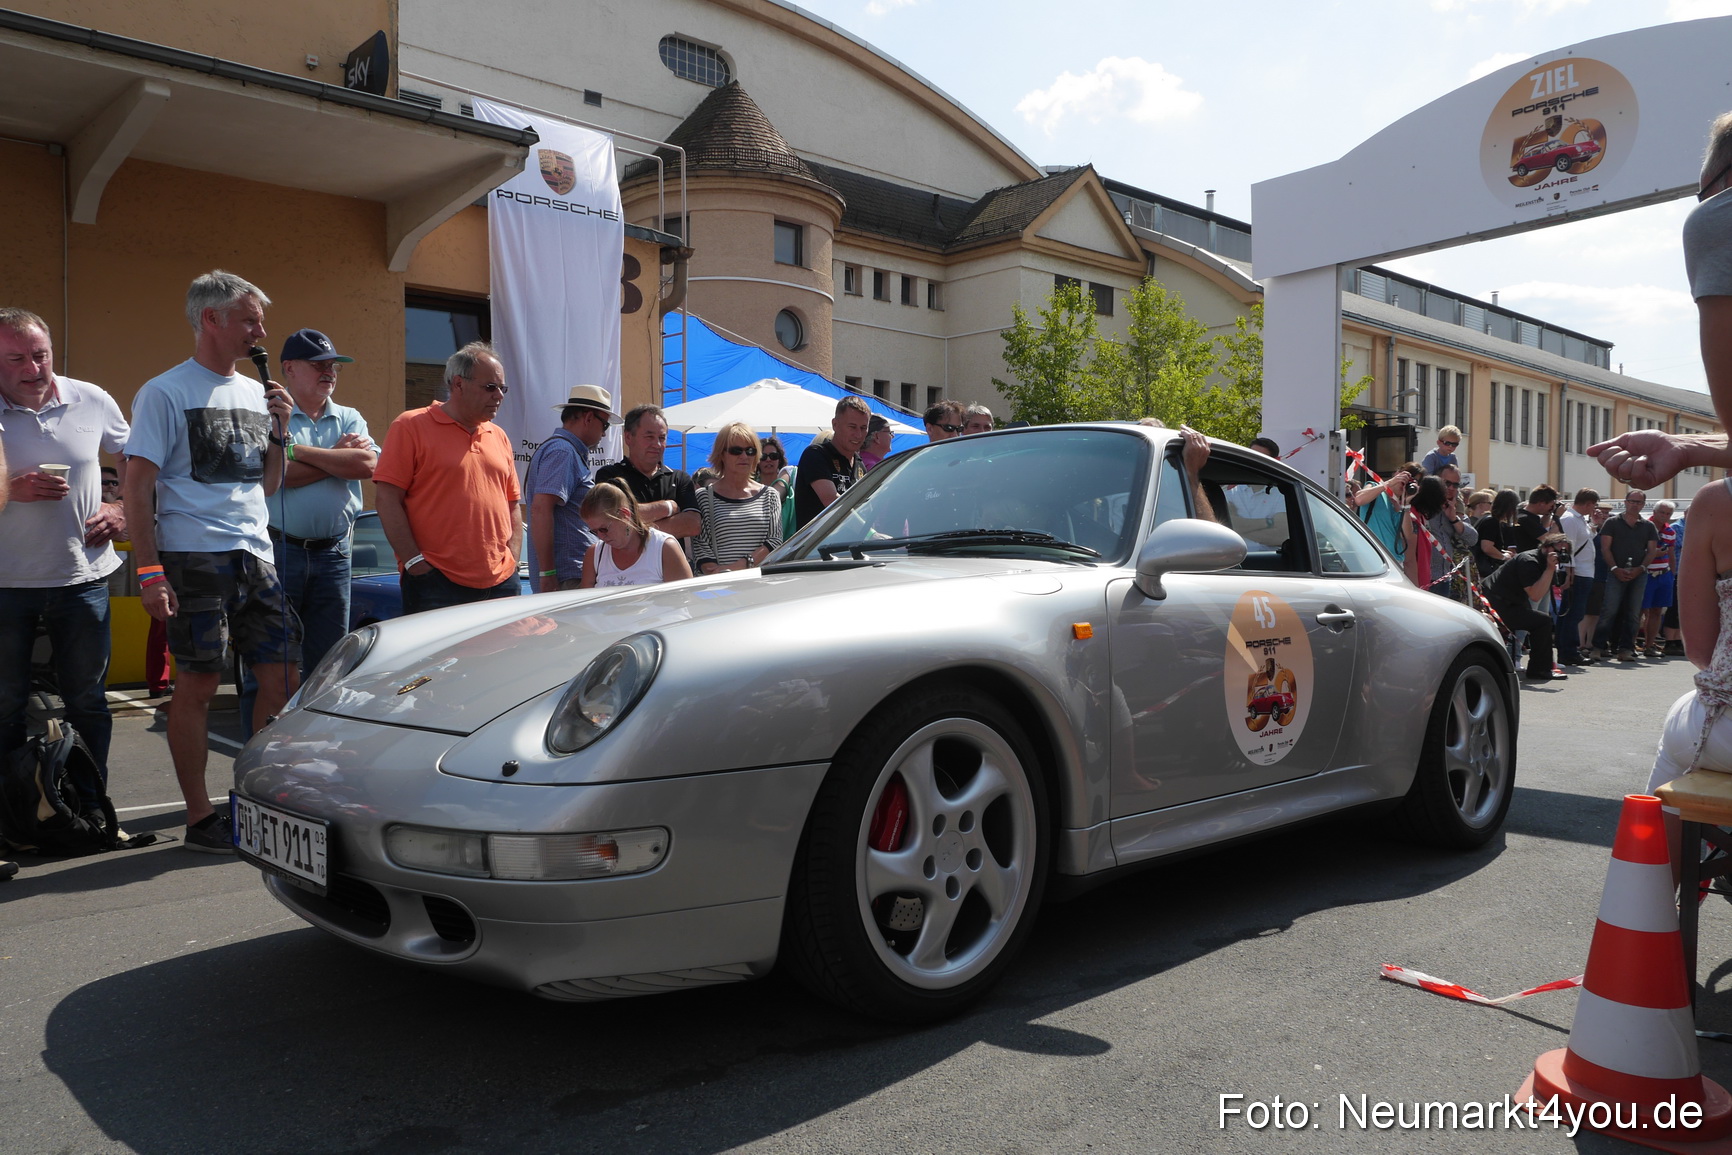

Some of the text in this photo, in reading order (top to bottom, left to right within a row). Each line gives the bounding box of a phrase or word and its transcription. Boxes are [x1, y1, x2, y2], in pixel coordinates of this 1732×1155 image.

[347, 56, 371, 89] sky
[1528, 63, 1580, 100] ZIEL
[1511, 86, 1600, 118] PORSCHE
[1542, 103, 1566, 116] 911
[1534, 175, 1579, 192] JAHRE
[496, 188, 619, 222] PORSCHE
[1252, 596, 1276, 629] 45
[1245, 636, 1292, 650] PORSCHE
[1263, 646, 1277, 656] 911
[1259, 727, 1284, 738] JAHRE
[237, 802, 314, 874] FÜ ET 911
